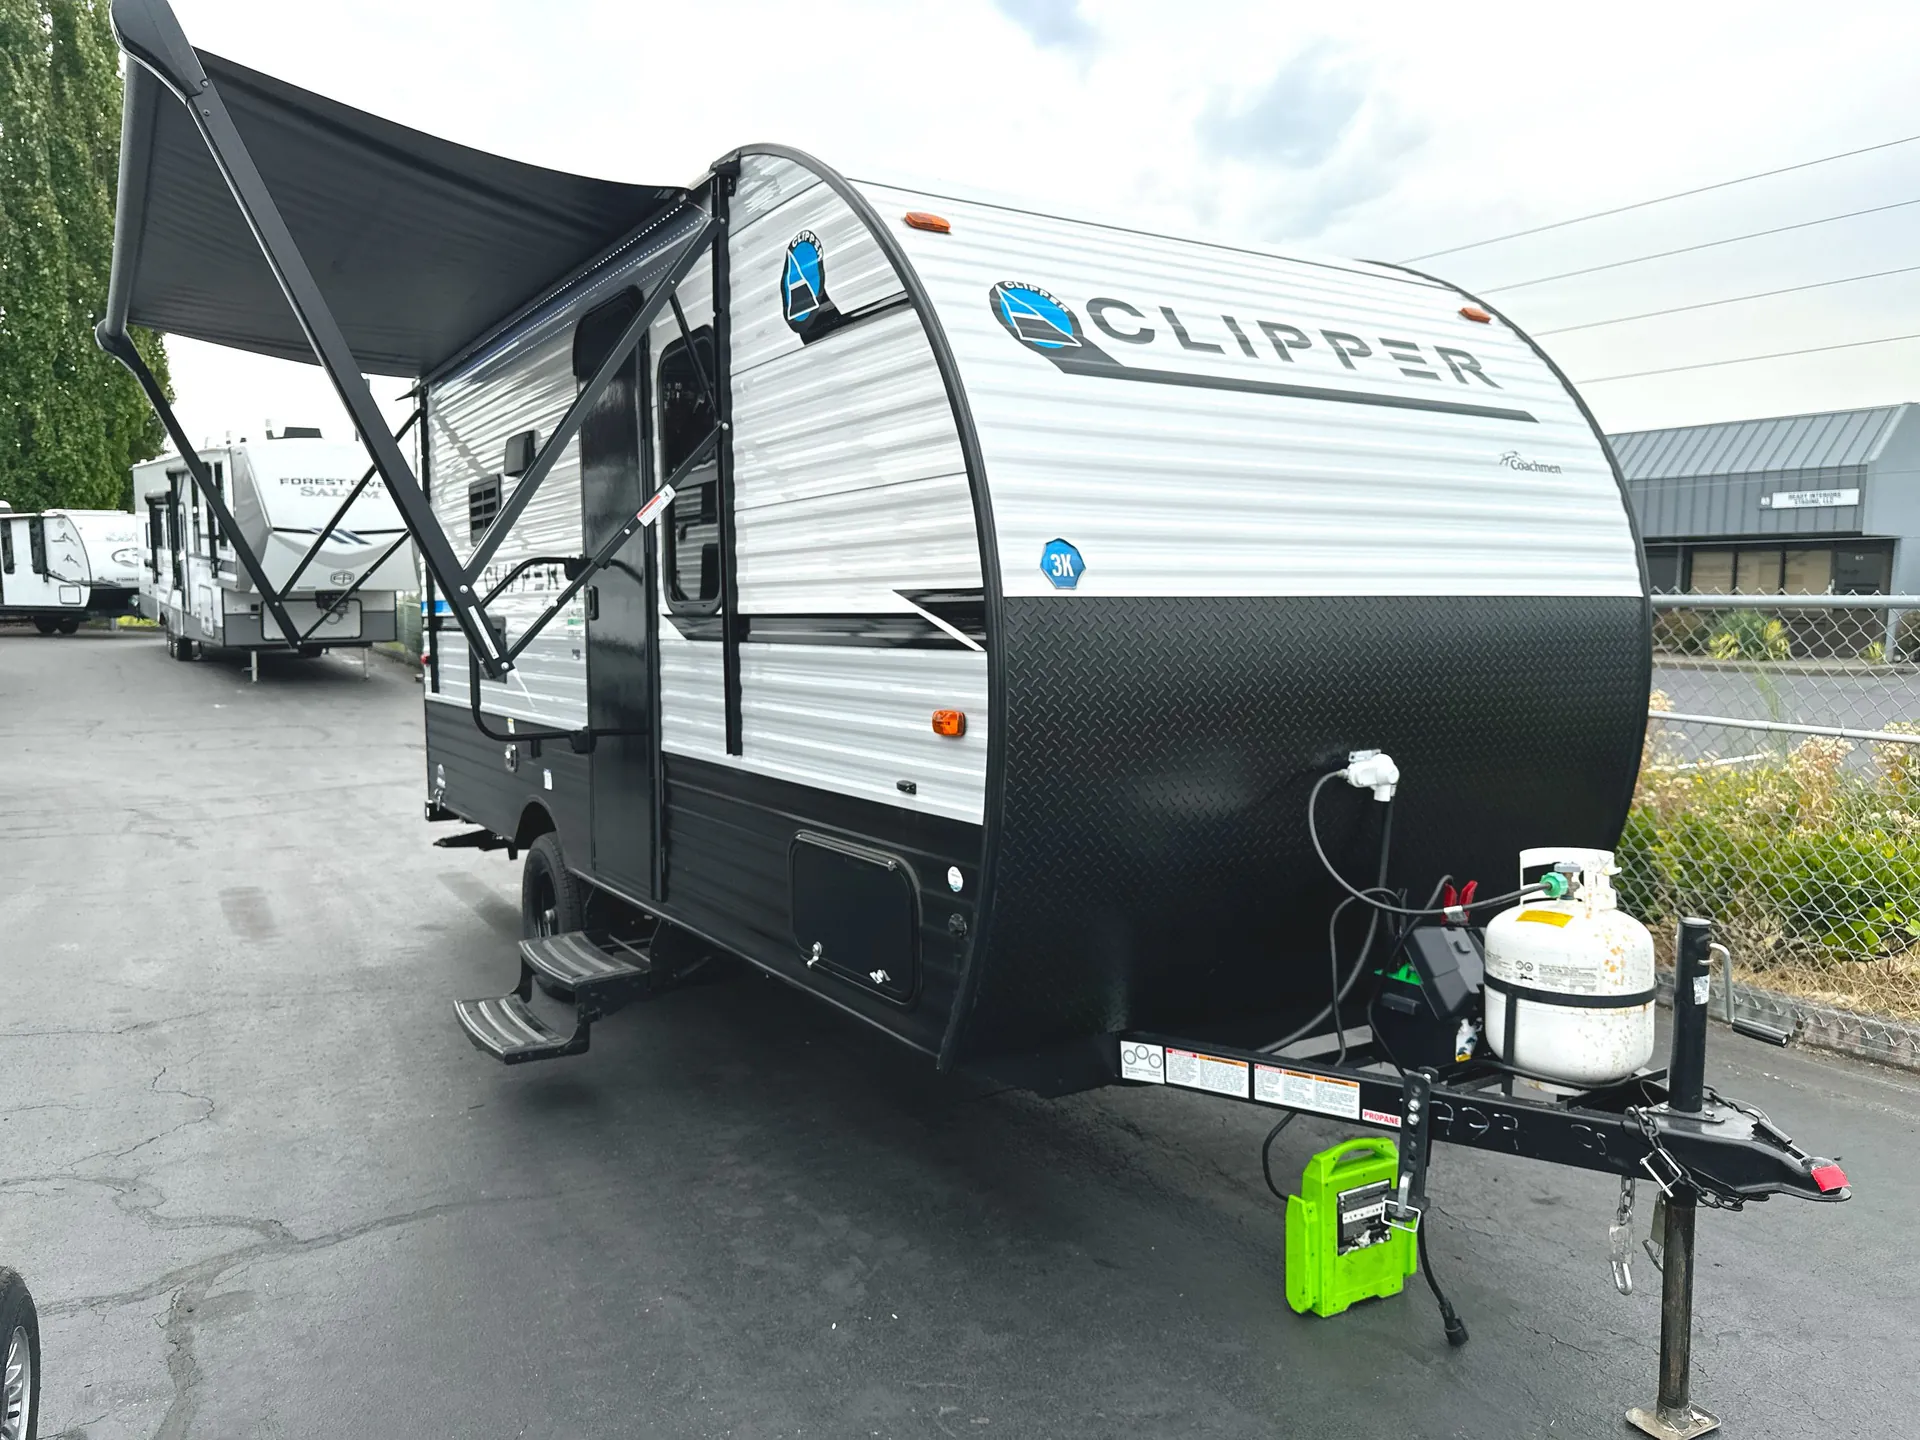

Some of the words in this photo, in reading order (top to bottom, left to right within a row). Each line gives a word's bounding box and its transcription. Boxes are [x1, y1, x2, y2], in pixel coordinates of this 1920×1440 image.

[792, 231, 823, 262] CLIPPER
[1003, 281, 1070, 313] CLIPPER
[1086, 297, 1503, 390] CLIPPER
[1510, 459, 1562, 474] Coachmen
[279, 477, 346, 486] FOREST
[1050, 553, 1075, 577] 3K
[1364, 1111, 1400, 1126] PROPANE
